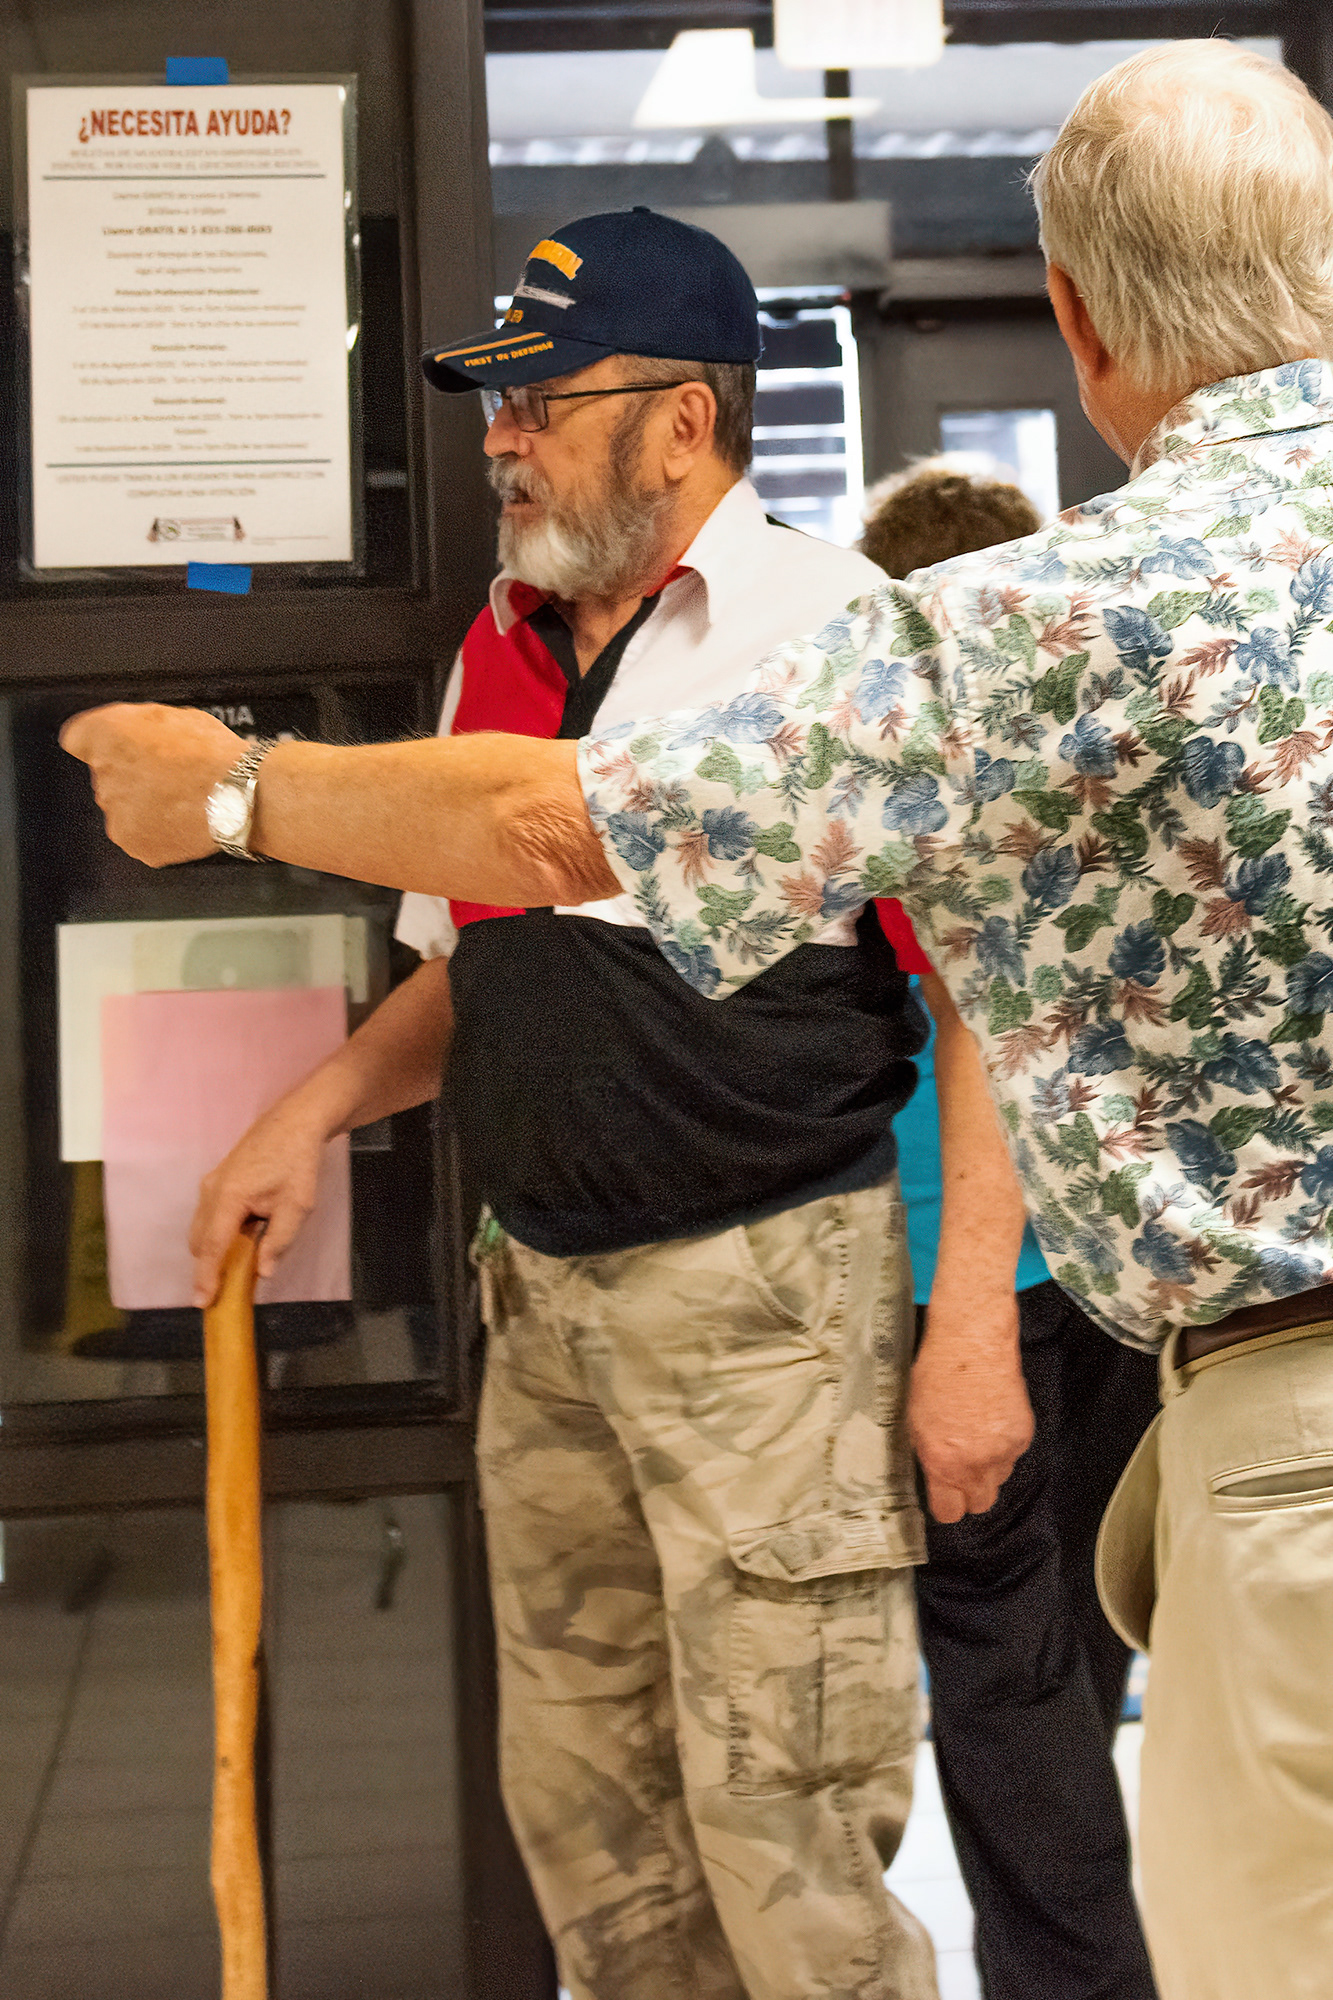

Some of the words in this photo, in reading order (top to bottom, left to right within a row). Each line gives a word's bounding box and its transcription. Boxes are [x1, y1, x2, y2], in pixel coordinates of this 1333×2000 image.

[78, 109, 200, 143] ¿NECESITA
[205, 108, 292, 136] AYUDA?
[464, 355, 492, 367] FIRST
[510, 341, 555, 359] DEFENSE
